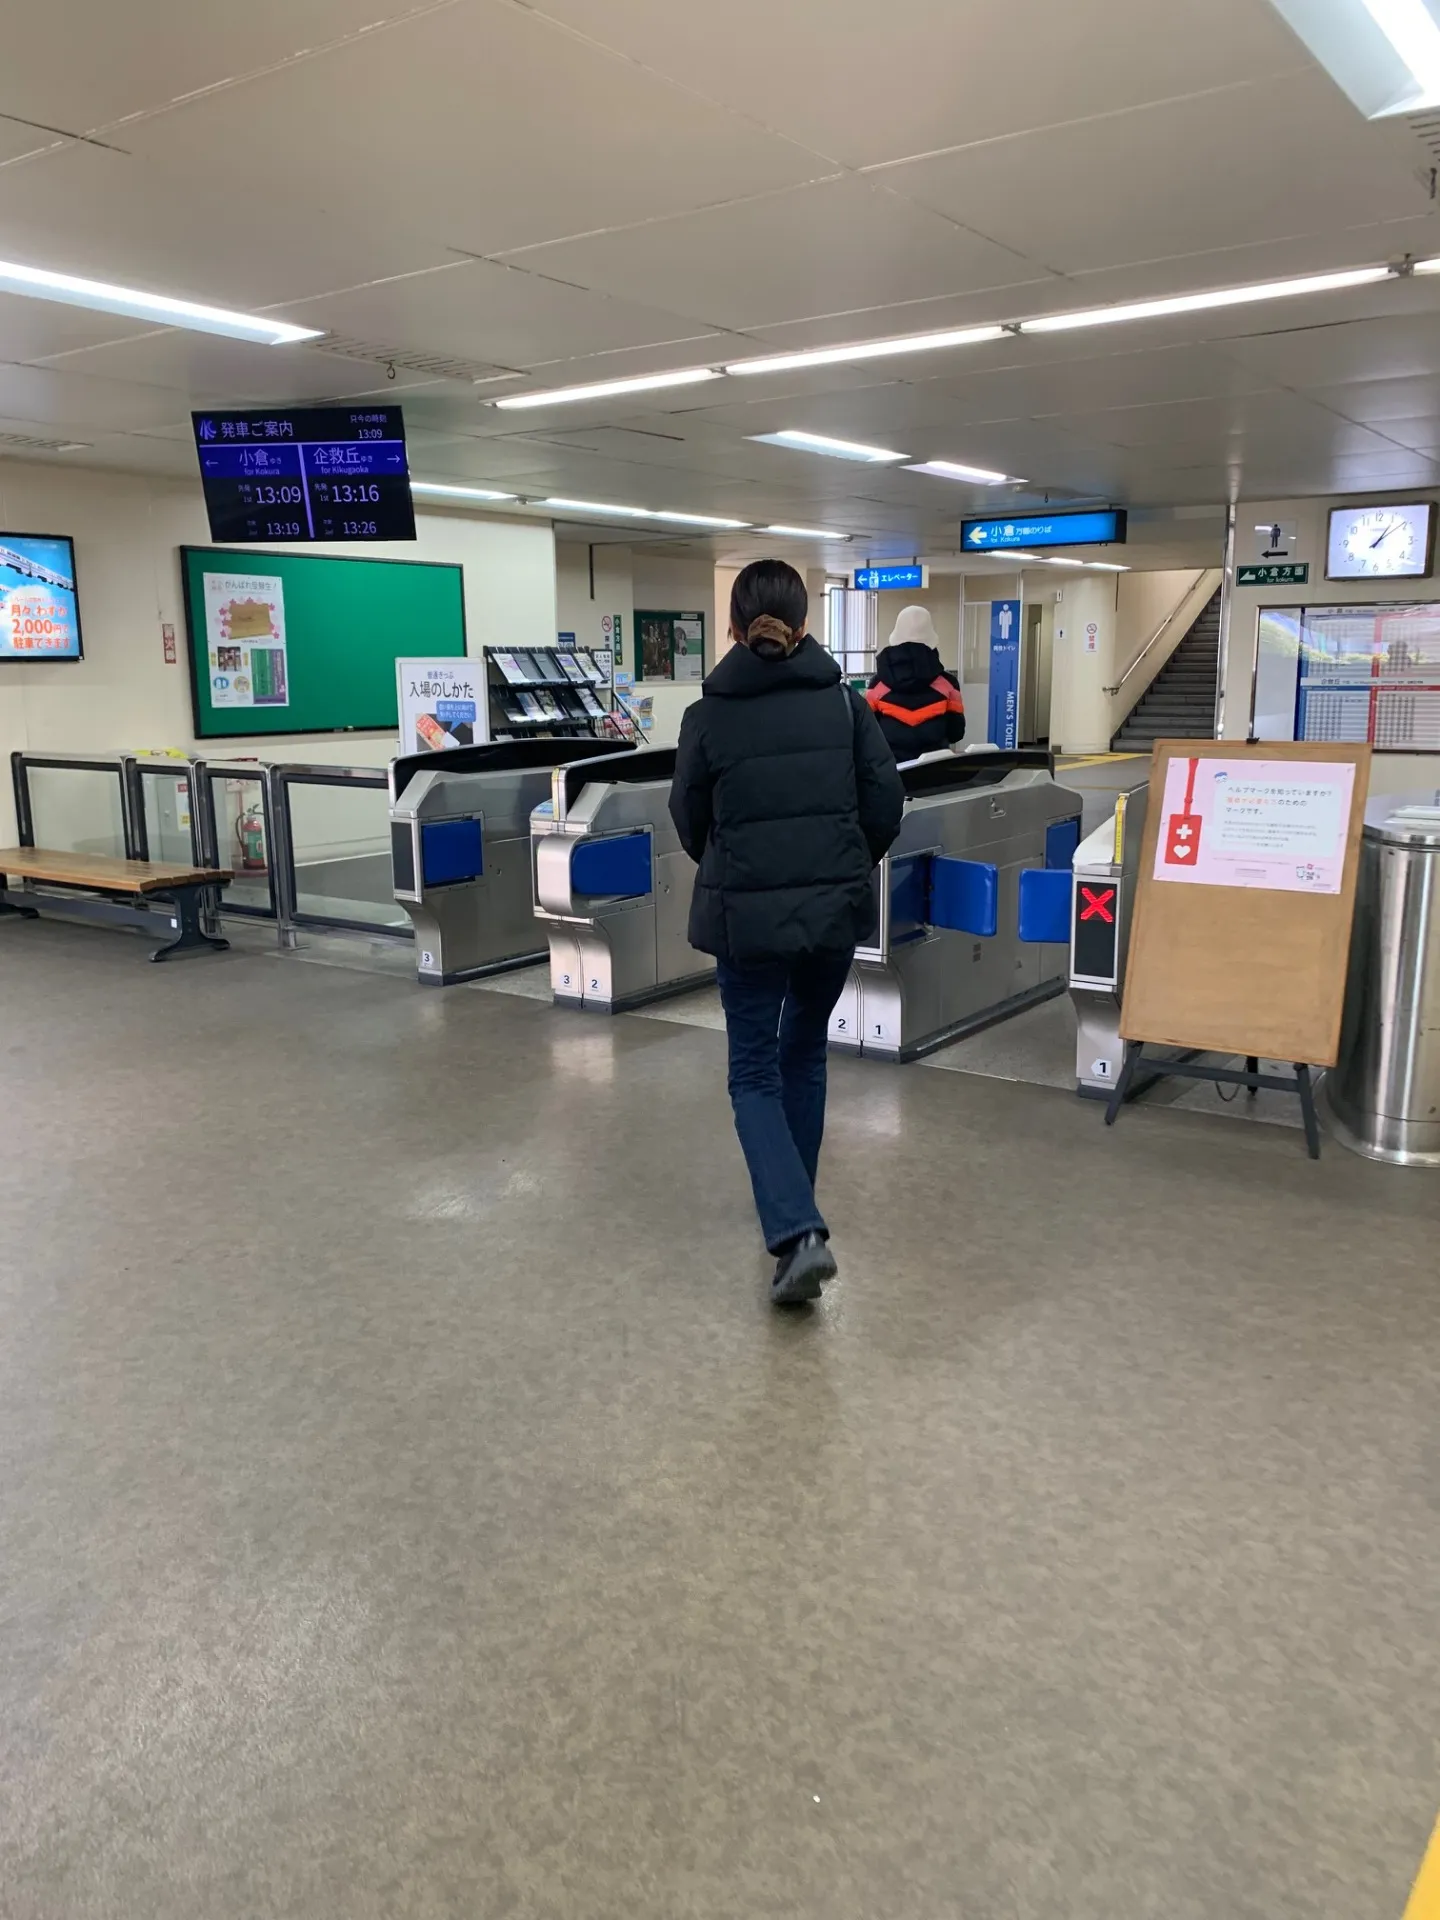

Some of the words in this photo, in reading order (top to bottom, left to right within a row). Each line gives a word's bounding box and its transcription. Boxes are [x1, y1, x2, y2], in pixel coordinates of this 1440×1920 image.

[221, 420, 293, 438] 発車ご案内
[358, 429, 383, 438] 13:09
[244, 467, 254, 475] for
[255, 467, 280, 475] Kokura
[321, 466, 331, 474] for
[332, 465, 369, 475] Kikugaoka
[255, 486, 301, 504] 13:09
[332, 484, 379, 502] 13:16
[1376, 513, 1384, 522] 12
[267, 522, 300, 535] 13:19
[343, 521, 377, 534] 13:26
[1343, 540, 1349, 548] 9
[1408, 536, 1414, 545] 3
[1348, 553, 1354, 561] 8
[1399, 551, 1405, 559] 4
[1361, 560, 1367, 568] 7
[1373, 563, 1379, 572] 6
[1258, 566, 1304, 578] 小倉方面
[881, 573, 918, 582] エレベーター
[427, 670, 454, 679] 普通きっぷ
[409, 681, 474, 698] 入場のしかた
[1006, 691, 1015, 720] MEN'S
[424, 953, 430, 962] 3
[563, 975, 570, 984] 3
[591, 979, 598, 989] 2
[838, 1018, 846, 1029] 2
[875, 1024, 881, 1035] 1
[1100, 1062, 1106, 1073] 1
